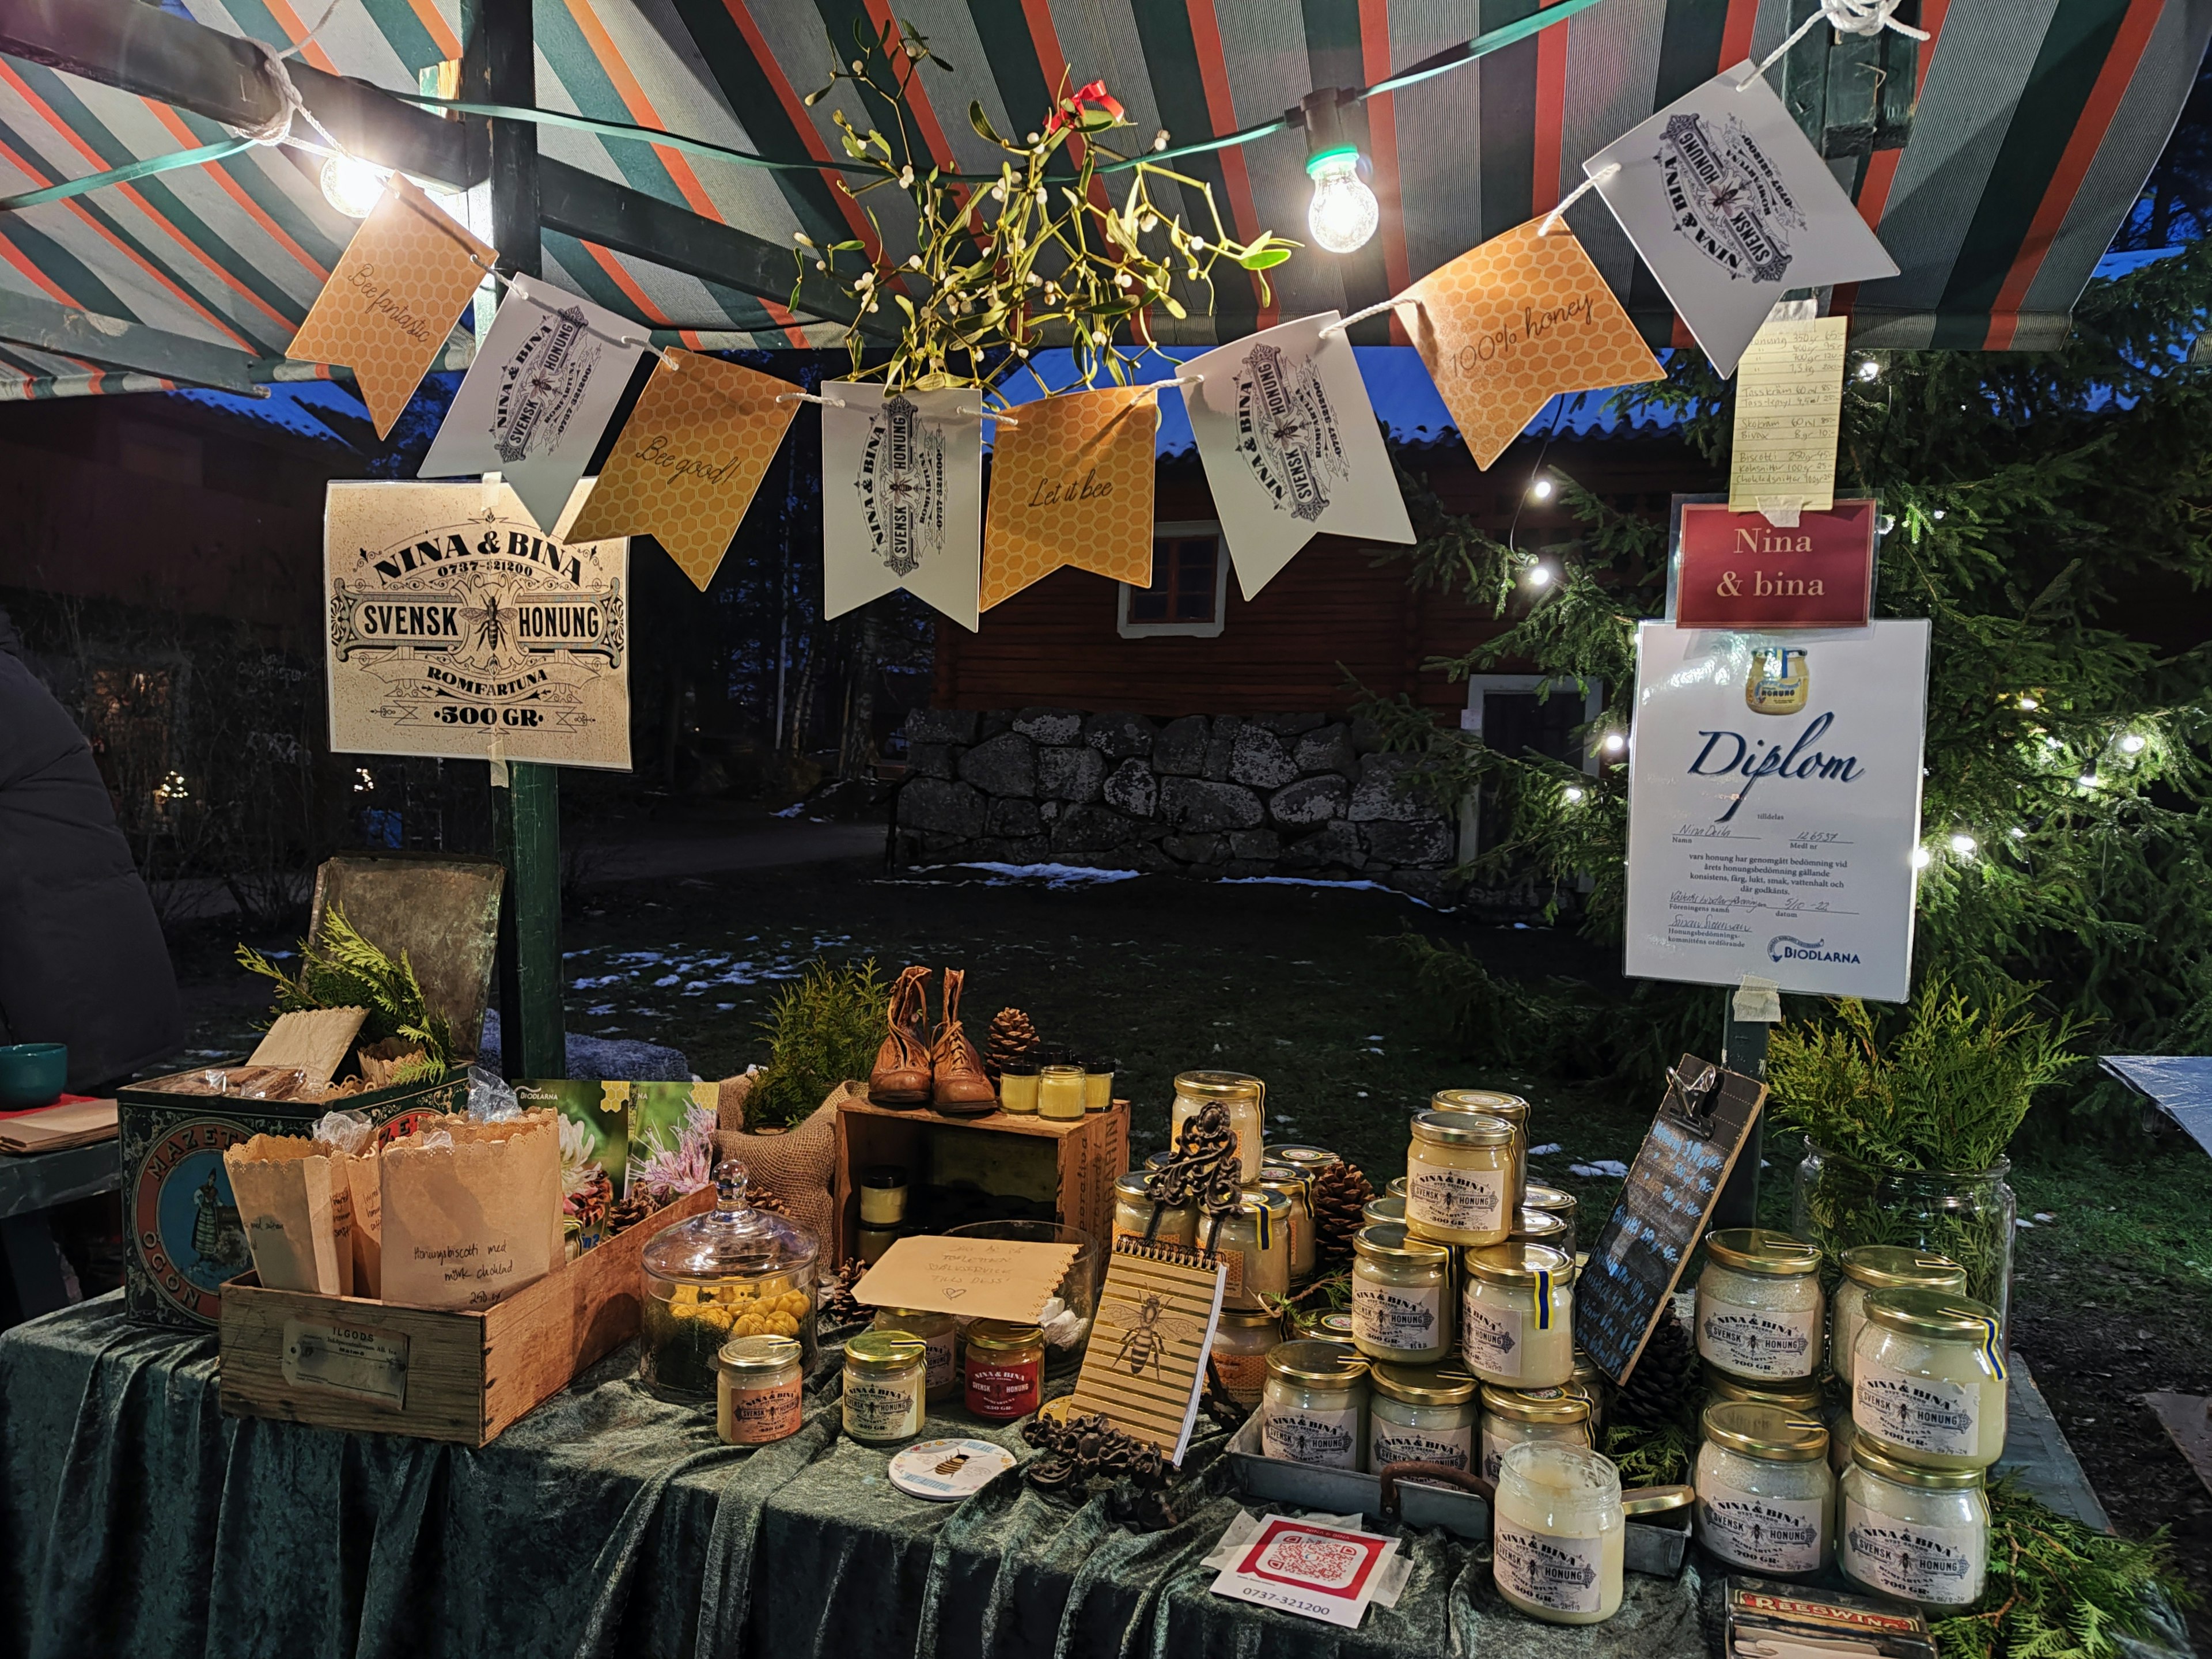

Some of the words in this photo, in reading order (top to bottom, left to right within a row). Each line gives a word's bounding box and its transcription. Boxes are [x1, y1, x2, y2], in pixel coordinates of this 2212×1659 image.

[1679, 132, 1720, 184] HONUNG
[1665, 156, 1688, 212] BINA
[1726, 149, 1771, 216] ROMFARTUNA
[1682, 212, 1698, 228] &
[1695, 228, 1743, 268] NINA
[1730, 211, 1771, 262] SVENSK
[348, 263, 377, 299] Bee
[368, 287, 431, 343] fantastic
[1450, 324, 1517, 377] 100%
[1525, 294, 1594, 339] honey
[1751, 337, 1786, 349] onung
[497, 382, 513, 429] NINA
[508, 366, 519, 381] &
[516, 325, 552, 365] BINA
[510, 399, 539, 444] SVENSK
[544, 323, 574, 372] HONUNG
[1257, 363, 1285, 416] HONUNG
[544, 362, 576, 423] ROMFARTUNA
[1240, 381, 1253, 434] BINA
[1294, 388, 1321, 459] ROMFARTUNA
[863, 426, 886, 476] BINA
[893, 416, 907, 470] HONUNG
[1243, 437, 1257, 452] &
[1740, 452, 1777, 461] Biscotti
[636, 436, 674, 468] Bee
[668, 457, 742, 486] good!
[1285, 448, 1313, 499] SVENSK
[863, 478, 873, 495] &
[919, 453, 933, 525] ROMFARTUNA
[1028, 478, 1062, 507] Let
[1065, 481, 1078, 501] it
[1080, 469, 1112, 498] bee
[1252, 456, 1285, 501] NINA
[863, 495, 885, 545] NINA
[893, 506, 907, 554] SVENSK
[1734, 528, 1812, 554] Nina
[373, 534, 471, 586] NINA
[477, 531, 501, 554] &
[508, 531, 581, 587] BINA
[437, 561, 533, 577] 0737-321200
[1717, 571, 1743, 597] &
[1753, 571, 1824, 596] bina
[364, 605, 458, 636] SVENSK
[518, 607, 599, 637] HONUNG
[426, 666, 548, 696] ROMFARTUNA
[442, 707, 496, 725] 500
[503, 709, 538, 726] GR
[1688, 711, 1865, 823] Diplom
[1680, 824, 1704, 835] Nina
[1706, 853, 1733, 863] honung
[1749, 857, 1788, 866] genomgått
[1790, 858, 1833, 869] bedömning
[1724, 865, 1797, 877] honungsbedömning
[1798, 869, 1830, 877] gällande
[1691, 873, 1729, 882] konsistens,
[1749, 876, 1765, 884] lukt,
[1791, 879, 1828, 887] vattenhalt
[1755, 887, 1790, 895] godkänts.
[1669, 904, 1709, 912] Föreningens
[1668, 936, 1706, 944] kommitténs
[1785, 946, 1861, 964] BIODLARNA
[520, 1092, 558, 1100] BIODLARNA
[1416, 1187, 1438, 1200] SVENSK
[1460, 1197, 1488, 1205] HONUNG
[414, 1244, 478, 1265] Honungsbiscotti
[487, 1240, 507, 1253] med
[445, 1270, 471, 1281] mörk
[470, 1292, 487, 1304] 250
[492, 1290, 503, 1305] gr
[333, 1328, 374, 1342] ILGODS
[1476, 1330, 1501, 1344] HONUNG
[1714, 1327, 1741, 1343] SVENSK
[1765, 1340, 1797, 1349] HONUNG
[1762, 1321, 1792, 1336] BINA
[972, 1381, 990, 1392] SVENSK
[1006, 1384, 1028, 1393] HONUNG
[1868, 1380, 1896, 1390] NINA
[1899, 1385, 1909, 1393] &
[1914, 1388, 1950, 1410] BINA
[1864, 1392, 1890, 1411] SVENSK
[1918, 1411, 1957, 1425] HONUNG
[1270, 1428, 1291, 1443] SVENSK
[1381, 1449, 1407, 1461] SVENSK
[1714, 1513, 1743, 1531] SVENSK
[1770, 1530, 1805, 1540] HONUNG
[1718, 1502, 1749, 1511] NINA
[1752, 1505, 1763, 1513] &
[1767, 1509, 1799, 1527] BINA
[1859, 1539, 1892, 1560] SVENSK
[1920, 1559, 1957, 1571] HONUNG
[1863, 1529, 1897, 1539] NINA
[1900, 1533, 1911, 1542] &
[1915, 1537, 1950, 1557] BINA
[1499, 1544, 1521, 1566] SVENSK
[1545, 1567, 1582, 1580] HONUNG
[1243, 1588, 1330, 1615] 0737-321200
